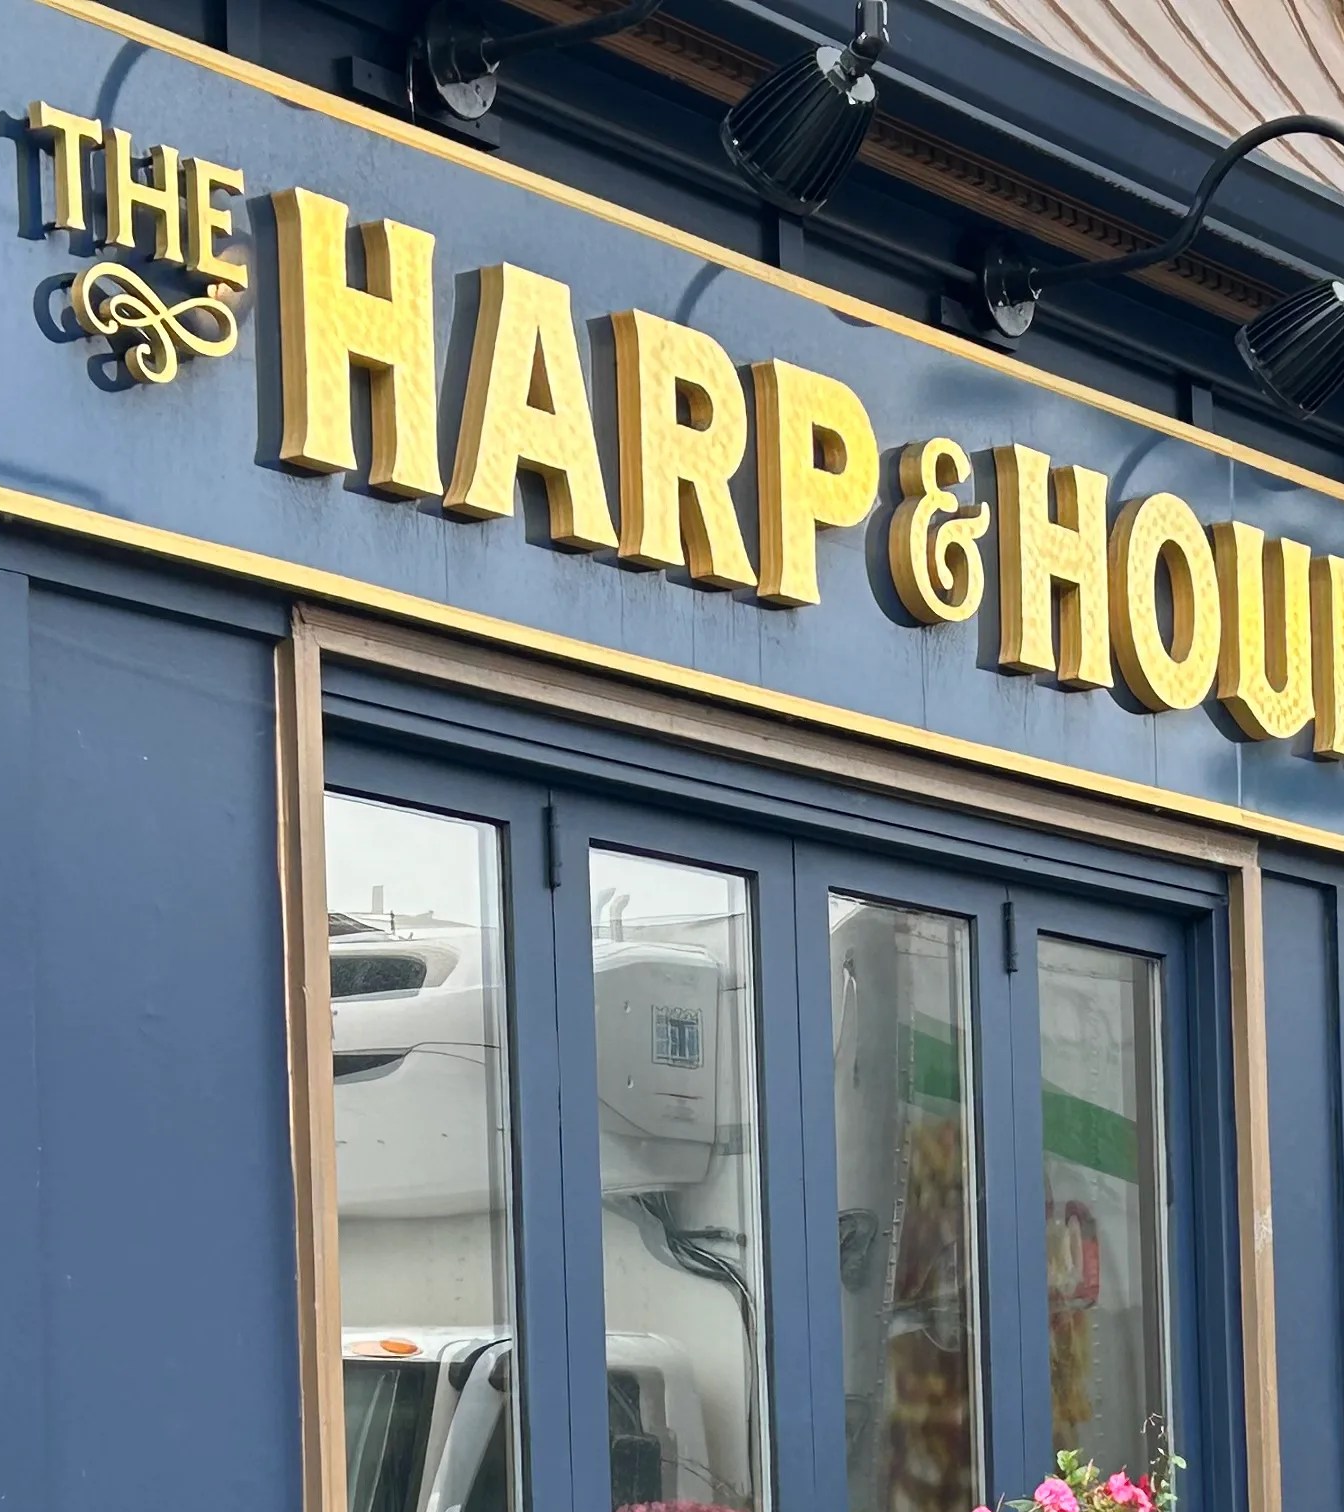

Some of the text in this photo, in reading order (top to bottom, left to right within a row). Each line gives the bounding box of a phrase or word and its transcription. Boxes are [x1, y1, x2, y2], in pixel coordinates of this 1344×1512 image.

[29, 101, 248, 291] THE
[272, 187, 879, 607] HARP
[889, 437, 991, 625] &
